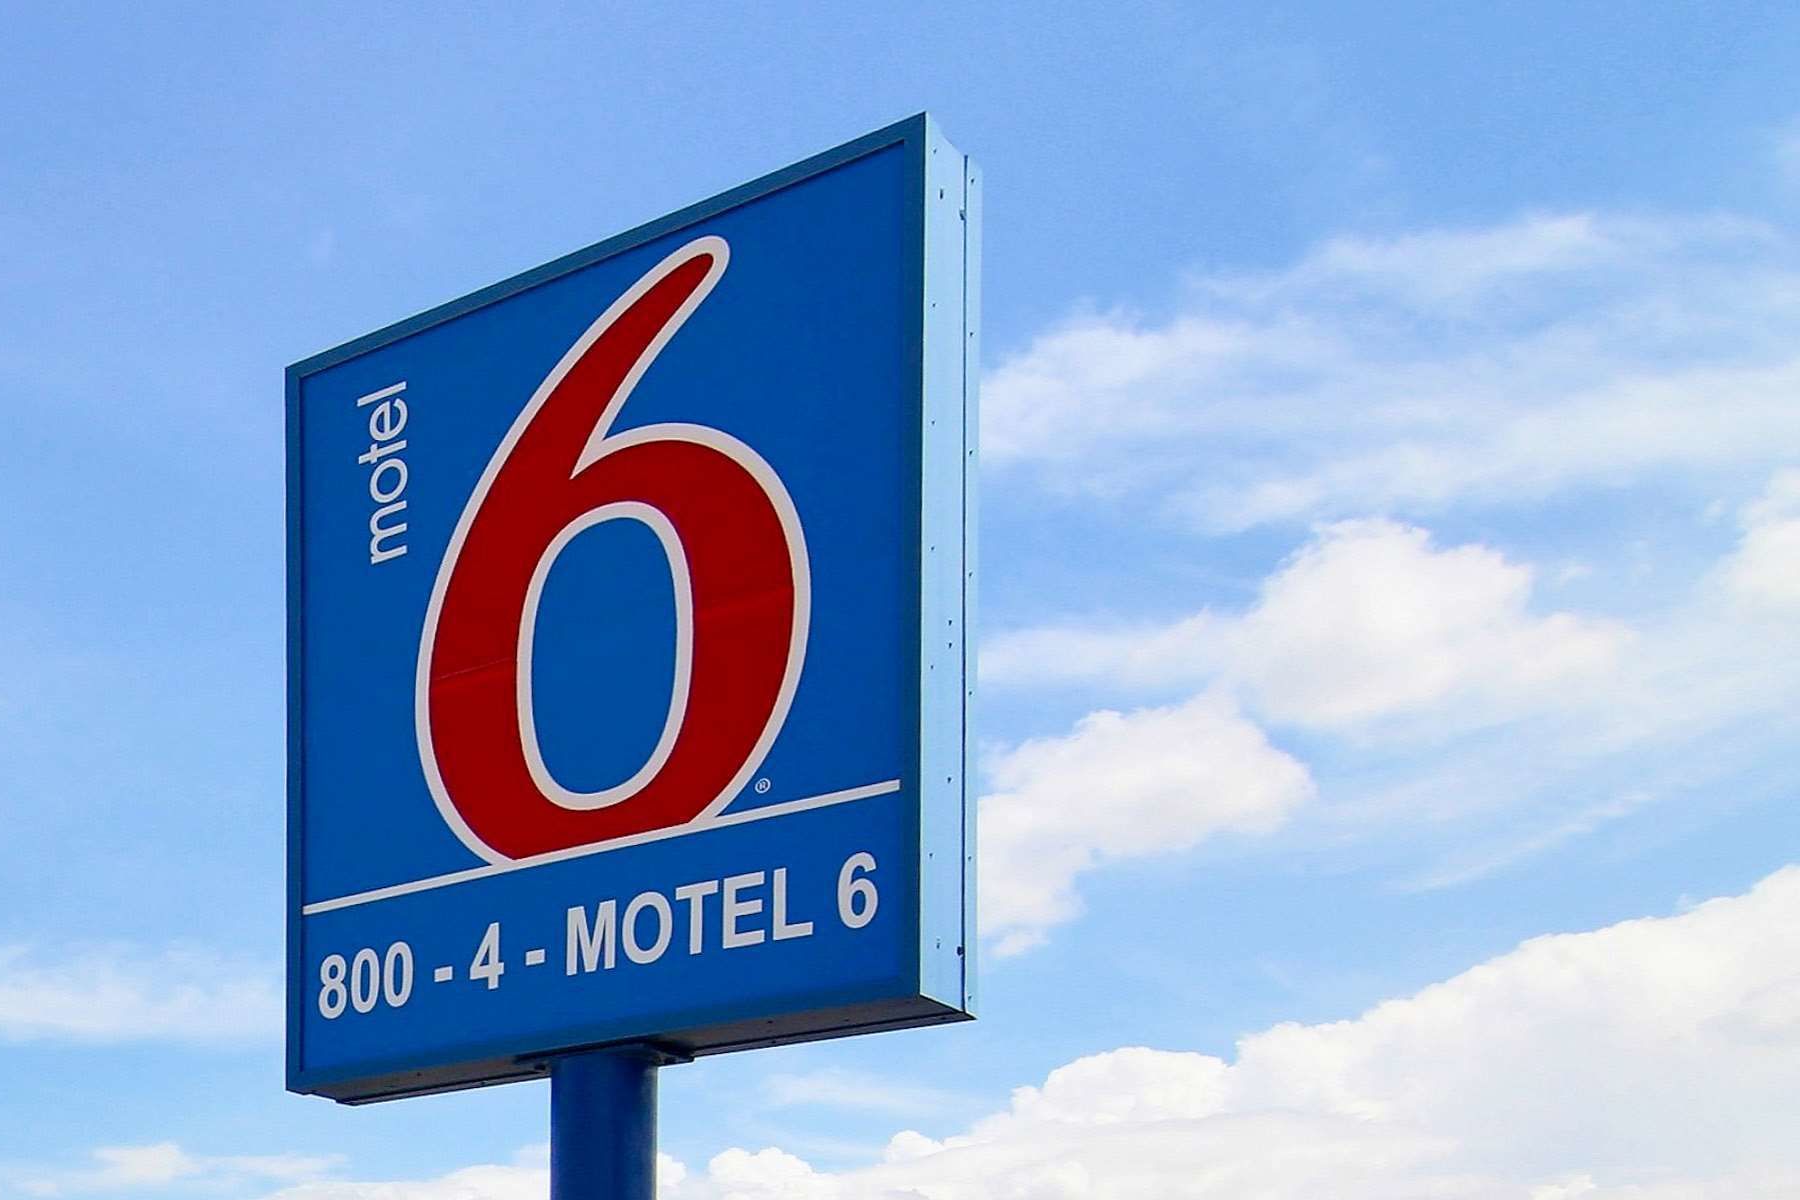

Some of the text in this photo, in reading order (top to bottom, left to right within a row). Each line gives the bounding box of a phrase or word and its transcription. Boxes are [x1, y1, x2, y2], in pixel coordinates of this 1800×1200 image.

[357, 381, 408, 564] motel
[415, 236, 811, 866] 6
[318, 941, 414, 1019] 800
[469, 922, 505, 990] 4
[566, 867, 814, 976] MOTEL
[837, 851, 878, 929] 6
